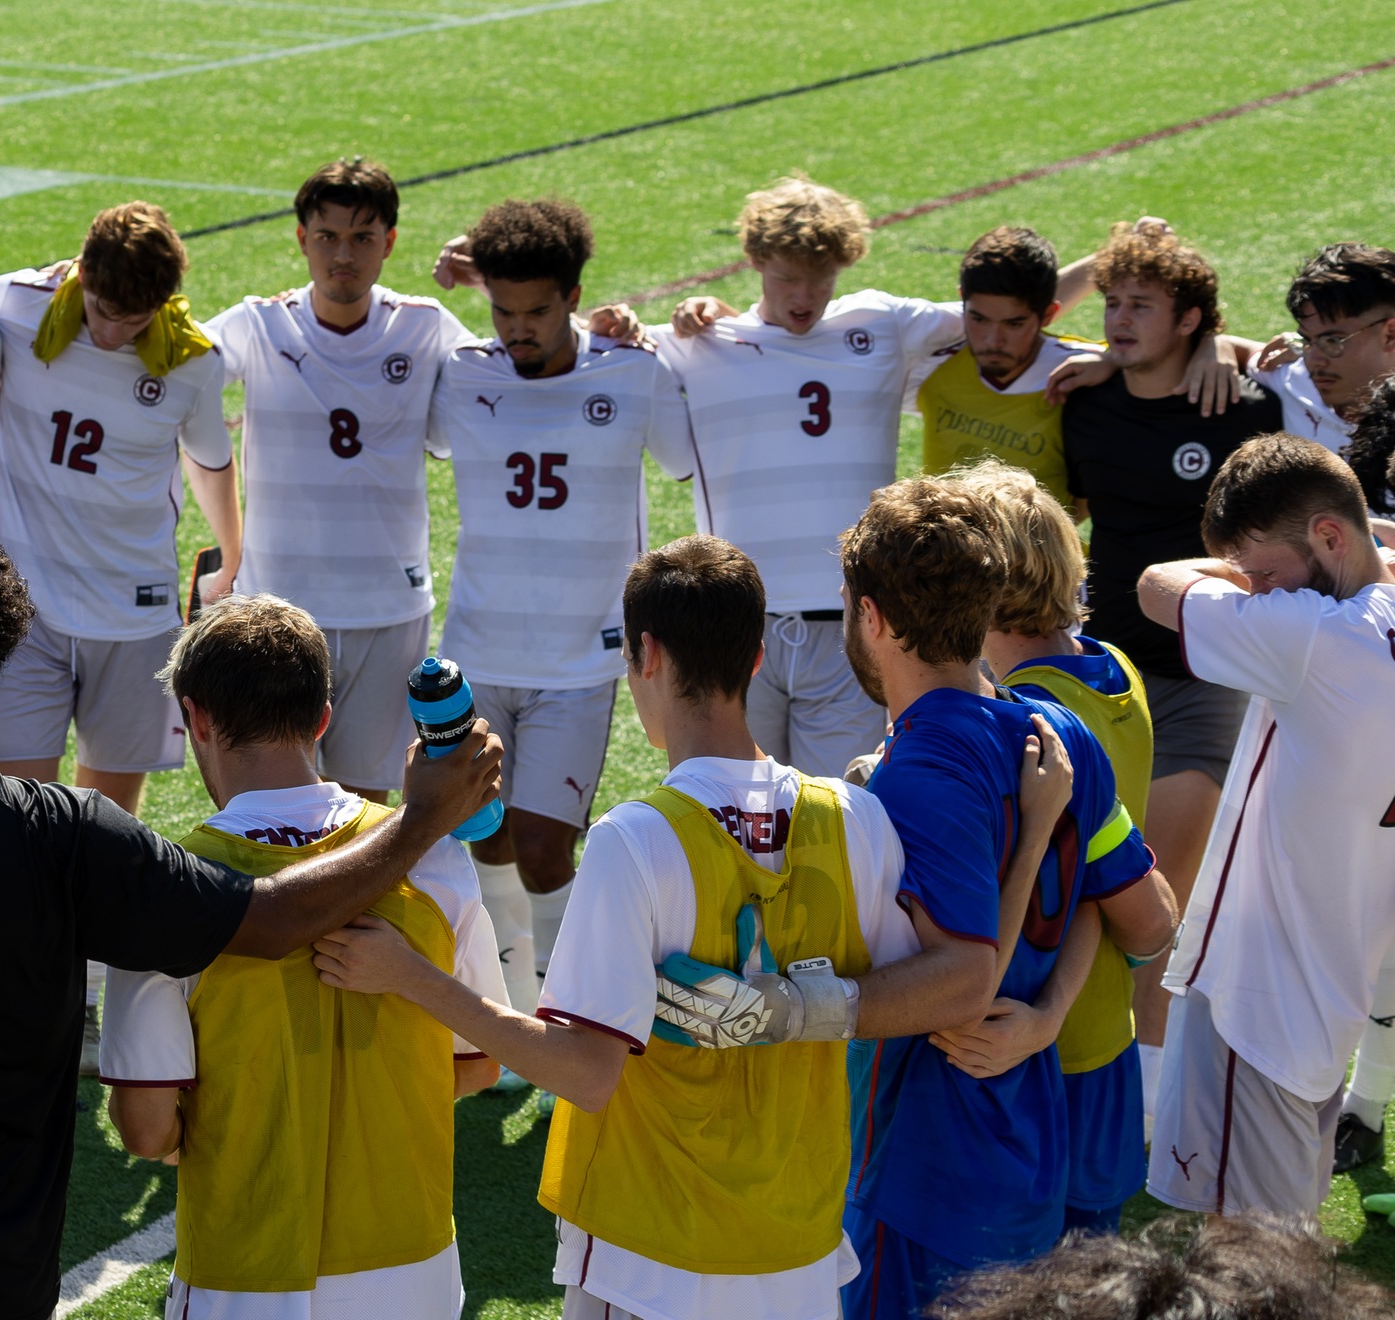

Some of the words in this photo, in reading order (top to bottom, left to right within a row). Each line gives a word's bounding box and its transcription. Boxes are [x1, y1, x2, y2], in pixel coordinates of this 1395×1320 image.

[329, 407, 363, 459] 8
[798, 380, 832, 437] 3
[50, 410, 105, 475] 12
[506, 451, 569, 510] 35
